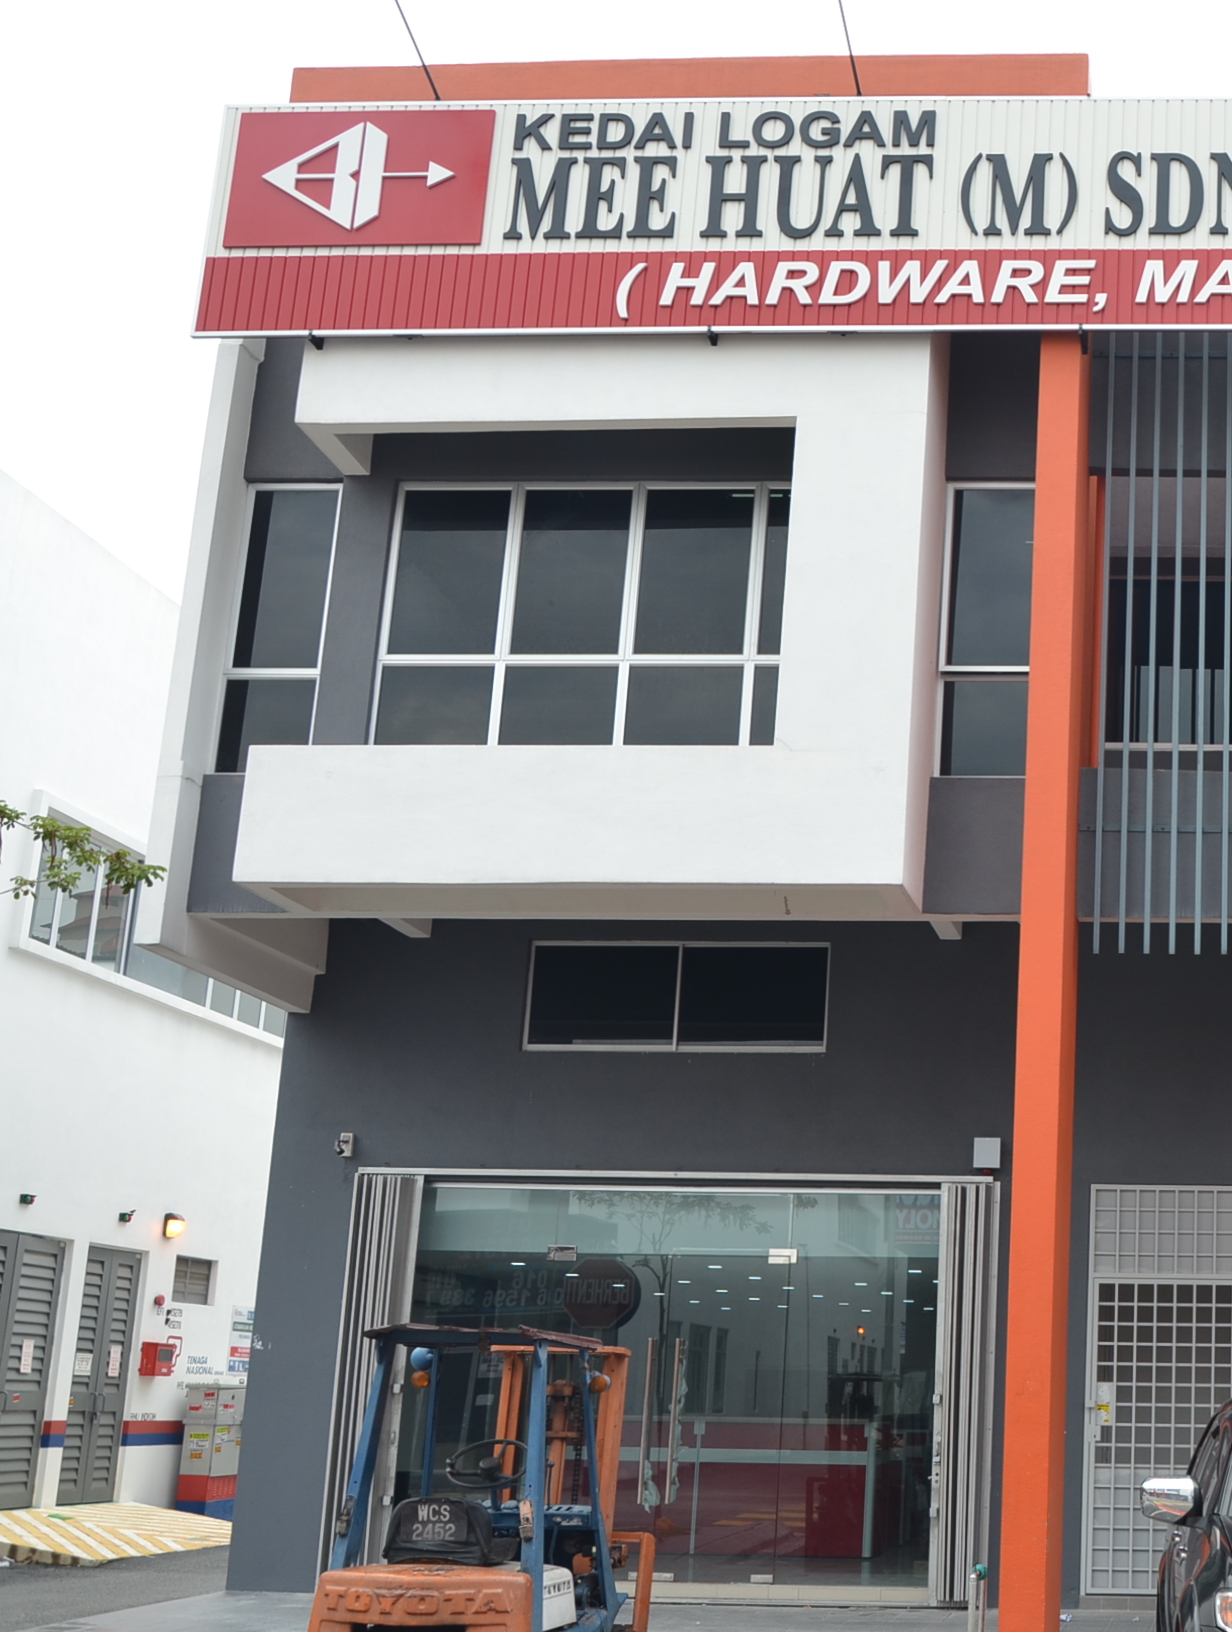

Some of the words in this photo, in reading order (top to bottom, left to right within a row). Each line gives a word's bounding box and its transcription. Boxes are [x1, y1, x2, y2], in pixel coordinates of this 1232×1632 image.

[513, 110, 695, 152] KEDAI
[718, 110, 937, 150] LOGAM
[503, 155, 679, 241] MEE
[698, 153, 935, 240] HUAT
[960, 152, 1079, 237] (M)
[187, 1355, 208, 1365] TENAGA
[185, 1365, 214, 1375] NASIONAL
[417, 1504, 451, 1522] WCS
[411, 1523, 456, 1541] 2452
[324, 1585, 513, 1615] TOYOTA
